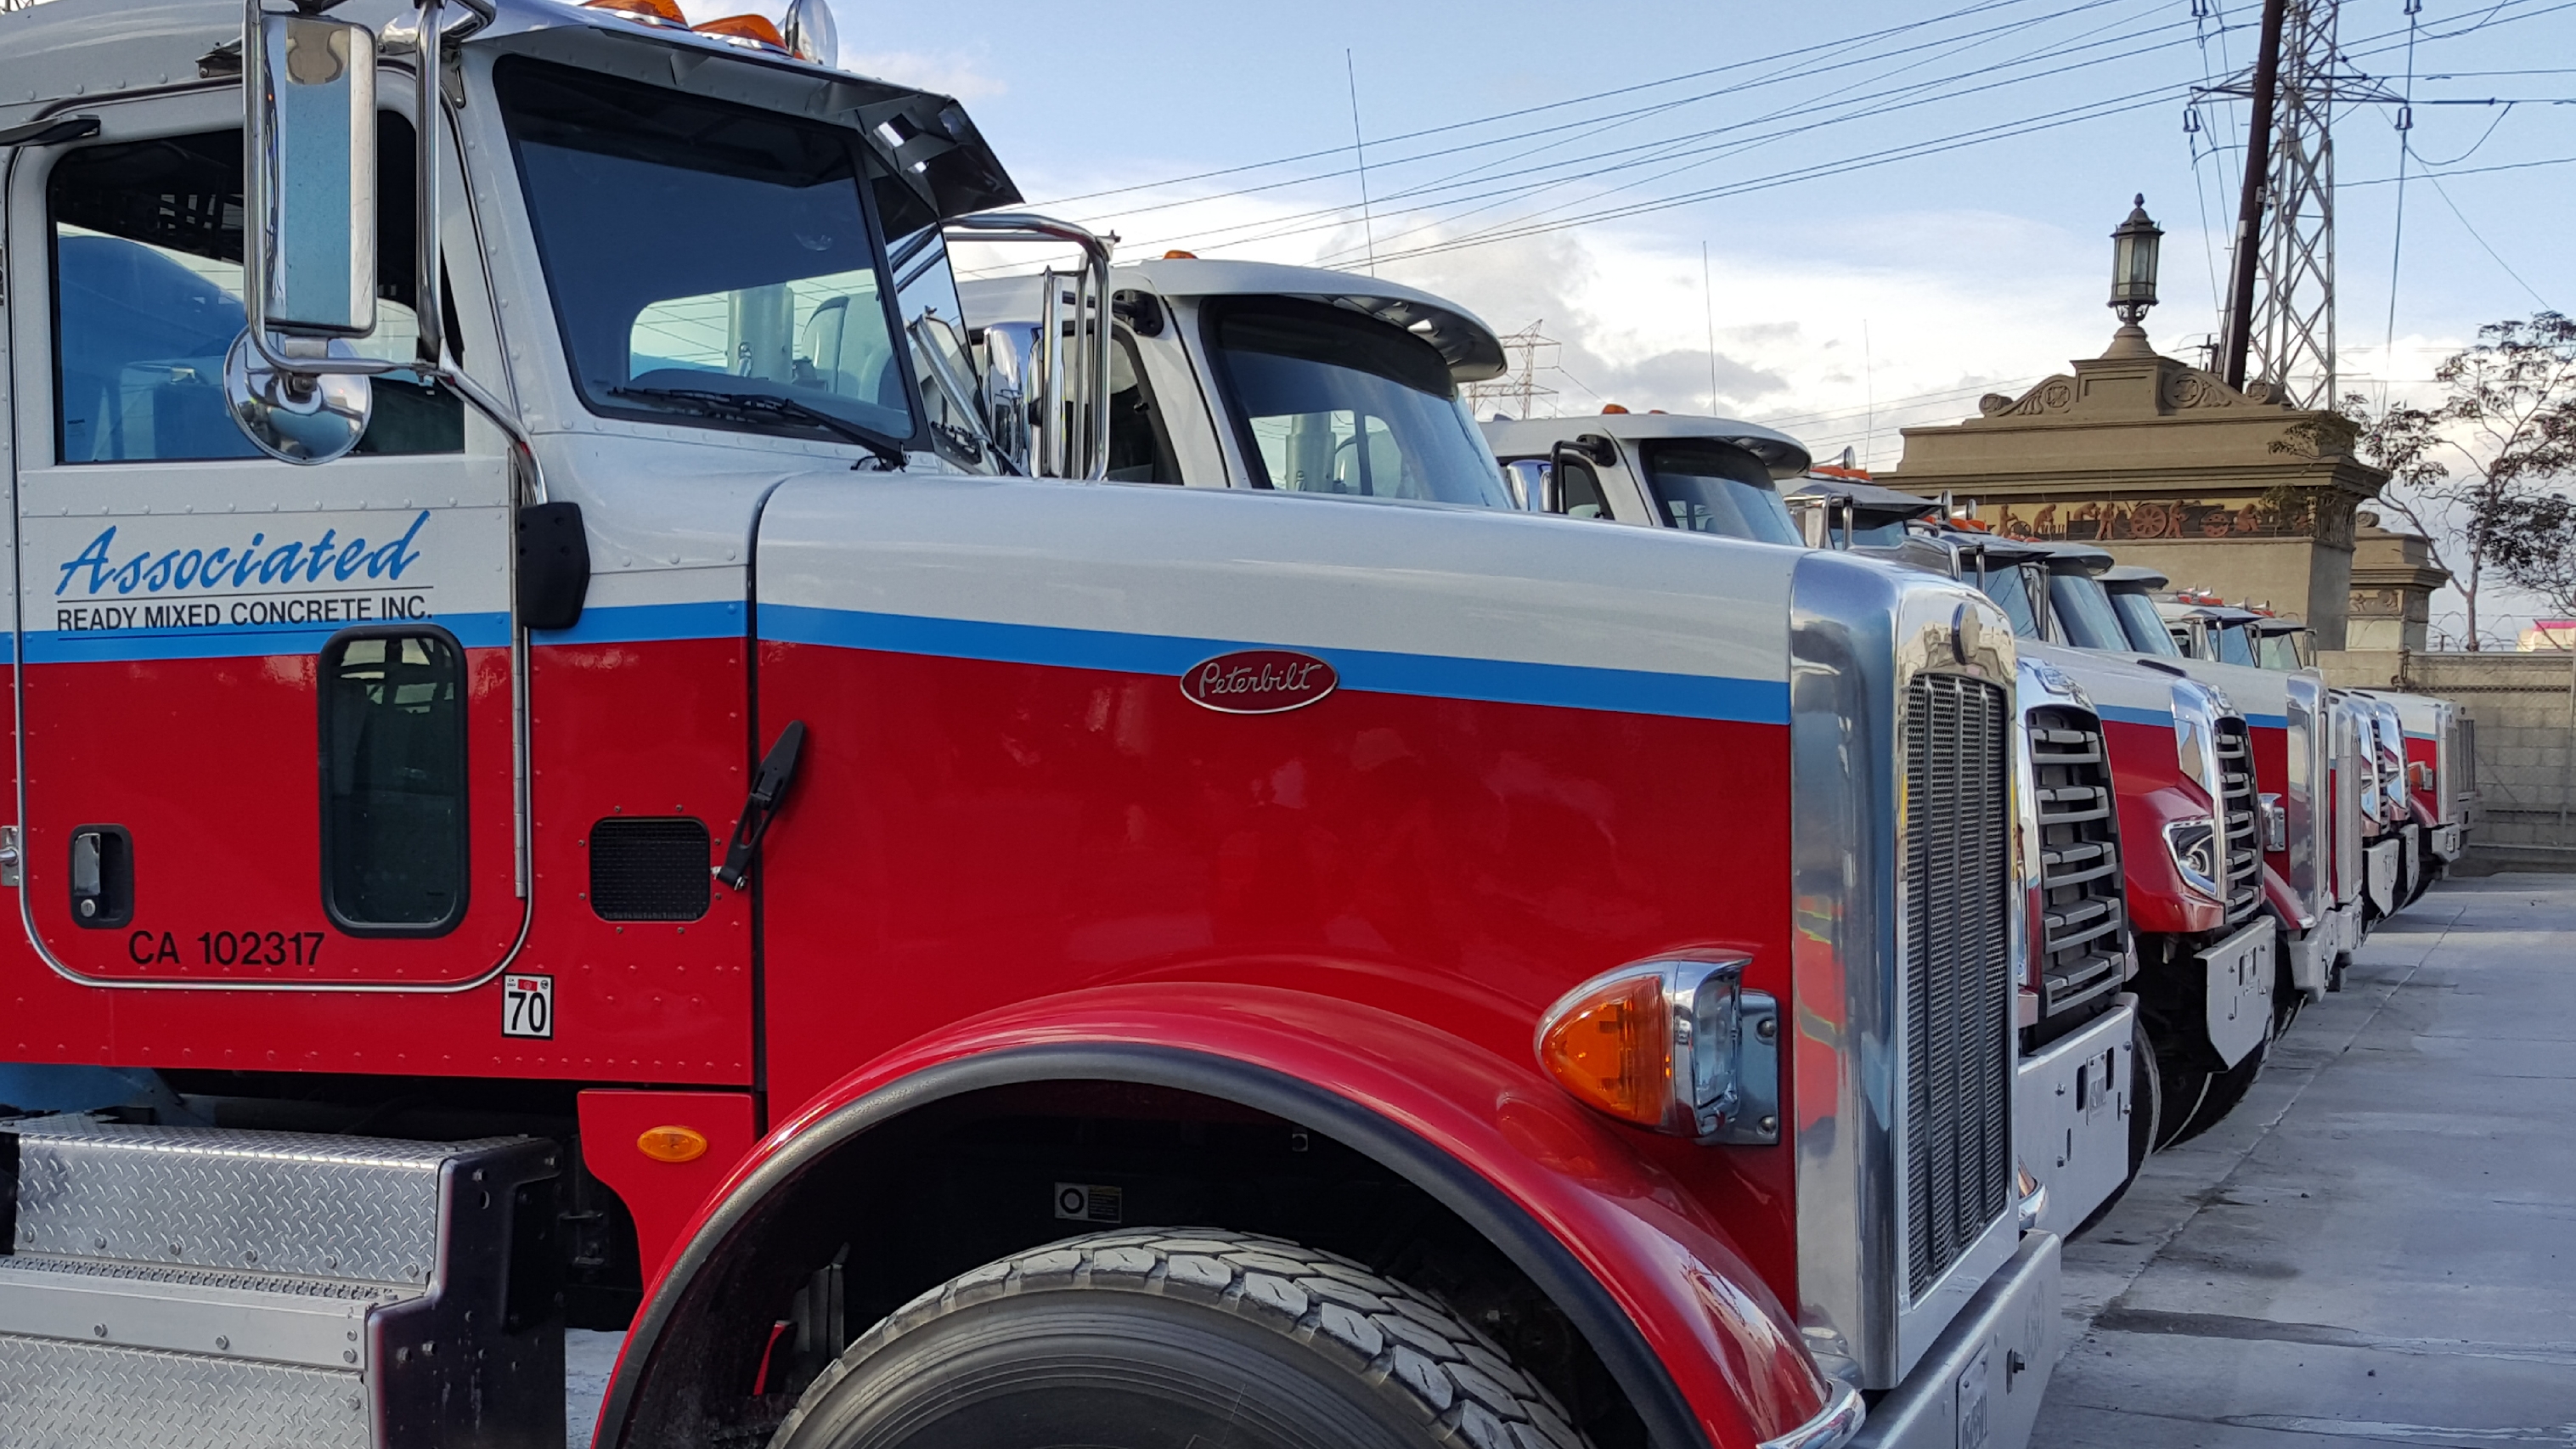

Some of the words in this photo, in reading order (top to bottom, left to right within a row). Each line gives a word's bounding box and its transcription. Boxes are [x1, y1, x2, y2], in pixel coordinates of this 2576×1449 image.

[55, 510, 431, 595] Associated
[57, 606, 138, 632] READY
[145, 603, 221, 629] MIXED
[230, 597, 372, 627] CONCRETE
[381, 595, 432, 621] INC.
[1198, 662, 1322, 698] Peterbilt
[128, 930, 181, 965] CA
[197, 931, 325, 967] 102317
[508, 991, 547, 1034] 70
